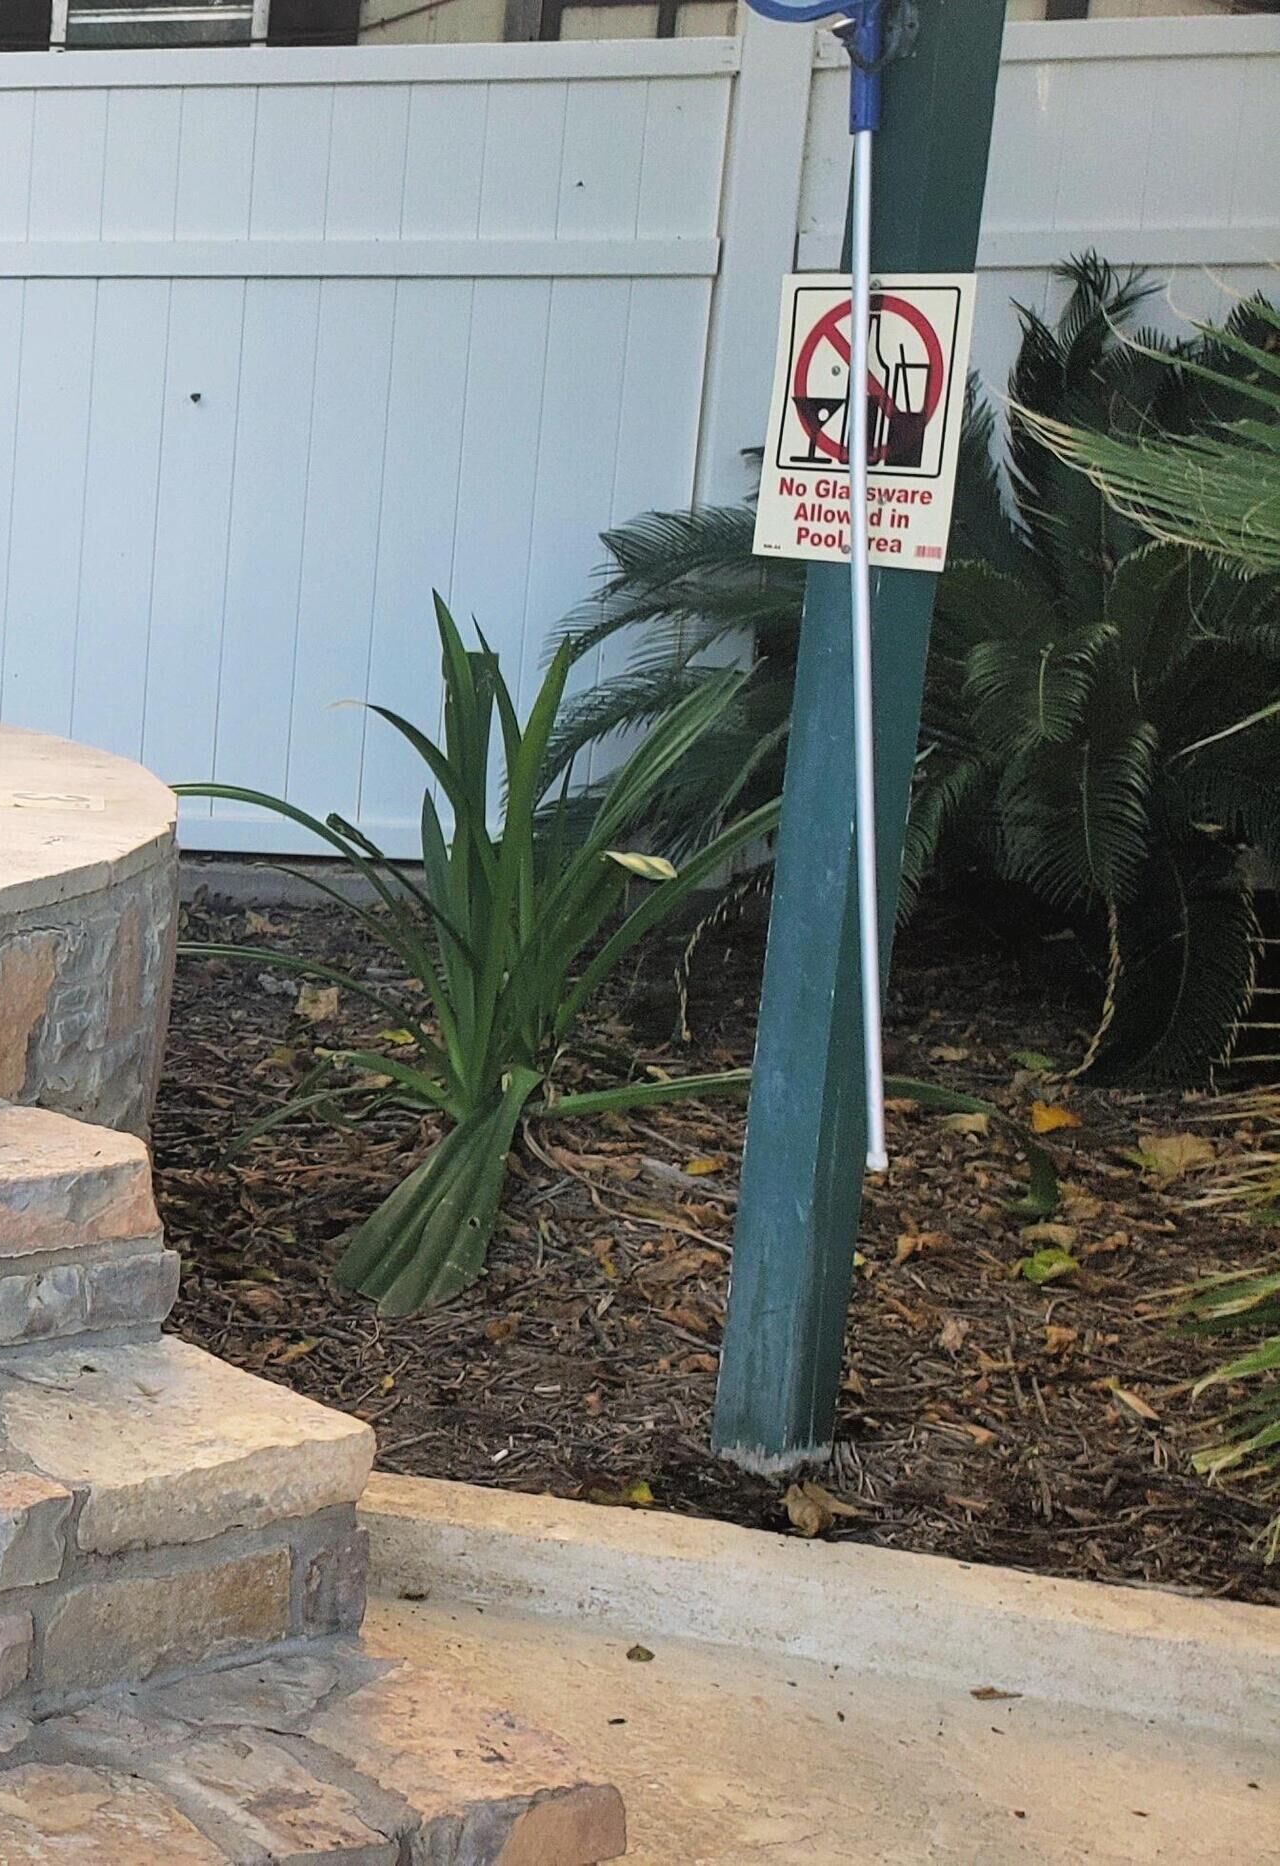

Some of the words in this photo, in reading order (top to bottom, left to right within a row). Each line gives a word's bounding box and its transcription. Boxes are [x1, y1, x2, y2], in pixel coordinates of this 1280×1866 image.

[779, 477, 807, 497] No
[815, 479, 933, 505] Glasware
[794, 503, 882, 526] Allowd
[890, 509, 909, 528] in
[797, 527, 843, 548] Pool
[855, 536, 902, 553] rea
